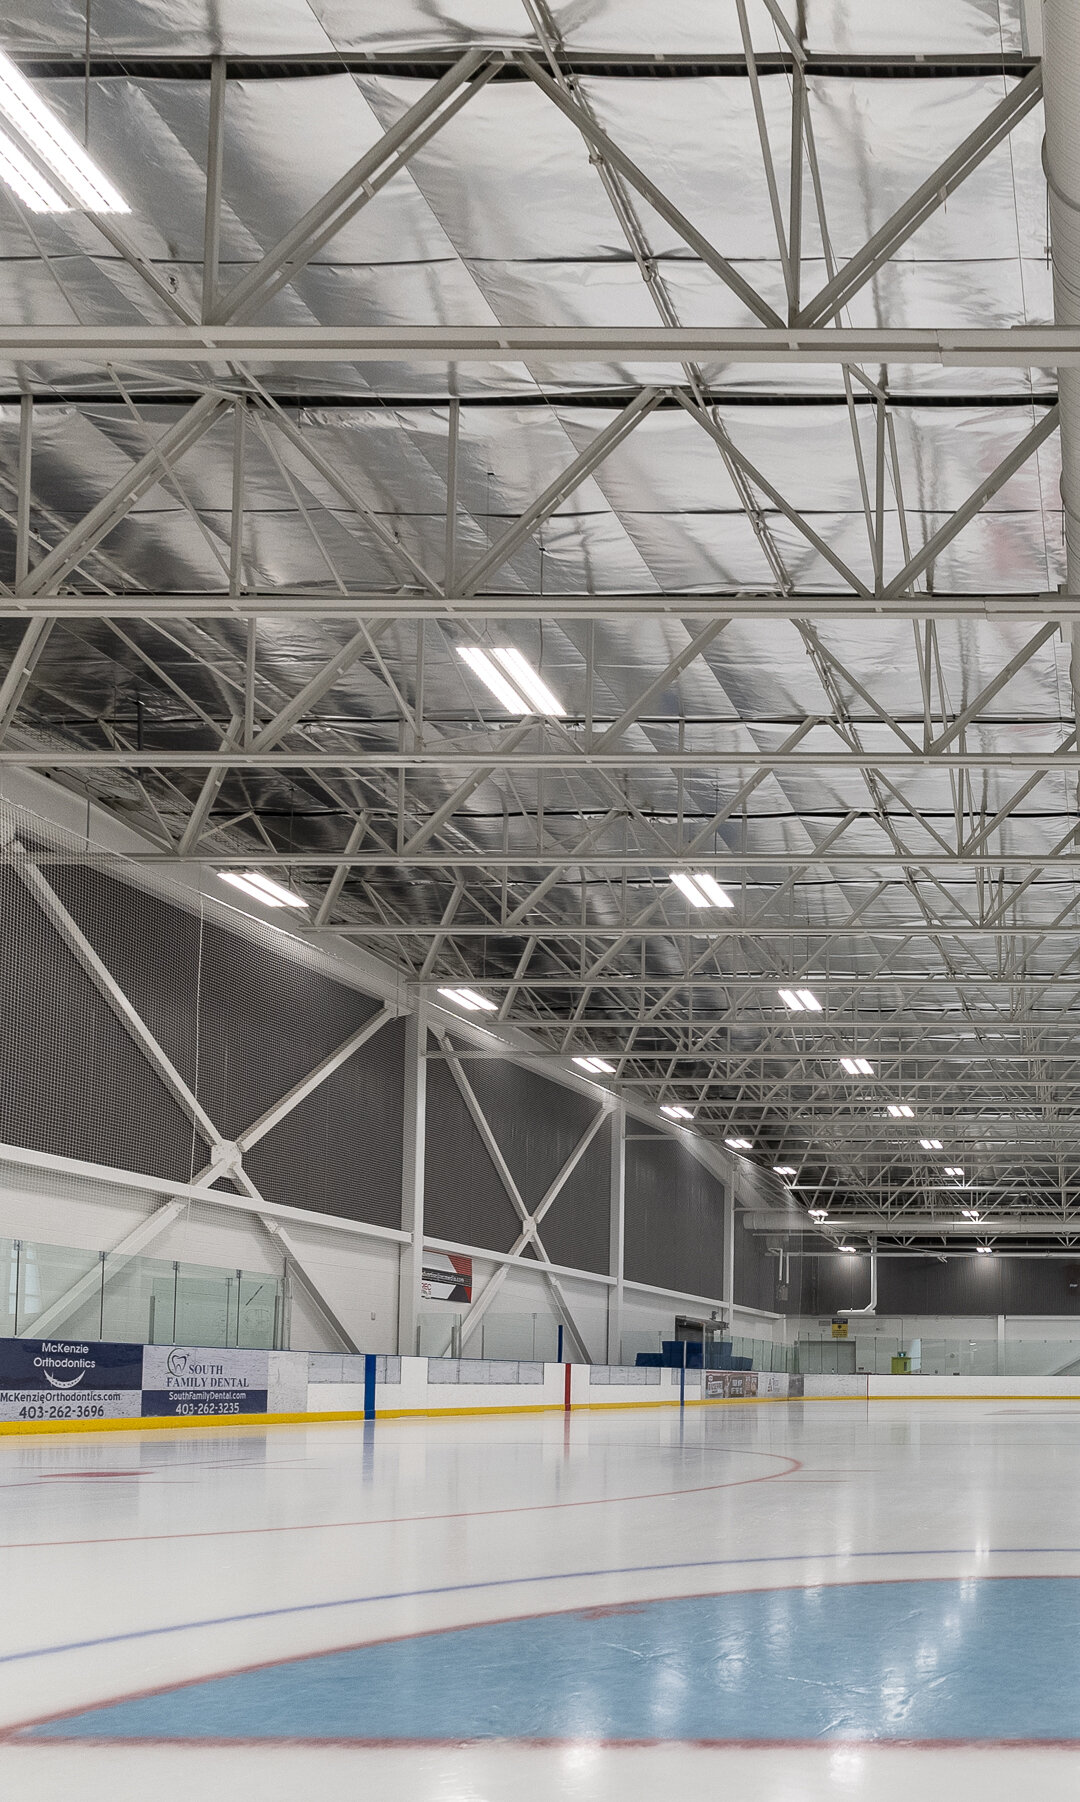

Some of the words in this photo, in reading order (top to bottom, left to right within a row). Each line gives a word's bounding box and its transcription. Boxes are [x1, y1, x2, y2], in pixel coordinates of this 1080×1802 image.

[42, 1342, 89, 1354] McKenzie
[33, 1357, 96, 1368] Orthodontics
[188, 1364, 223, 1375] SOUTH
[166, 1377, 208, 1388] FAMILY
[210, 1377, 250, 1388] DENTAL
[0, 1392, 121, 1403] McKenzieOrthodontics.com
[168, 1391, 247, 1402] SouthFamilyDental.com
[19, 1405, 104, 1419] 403-262-3696
[175, 1402, 240, 1415] 403-262-3235
